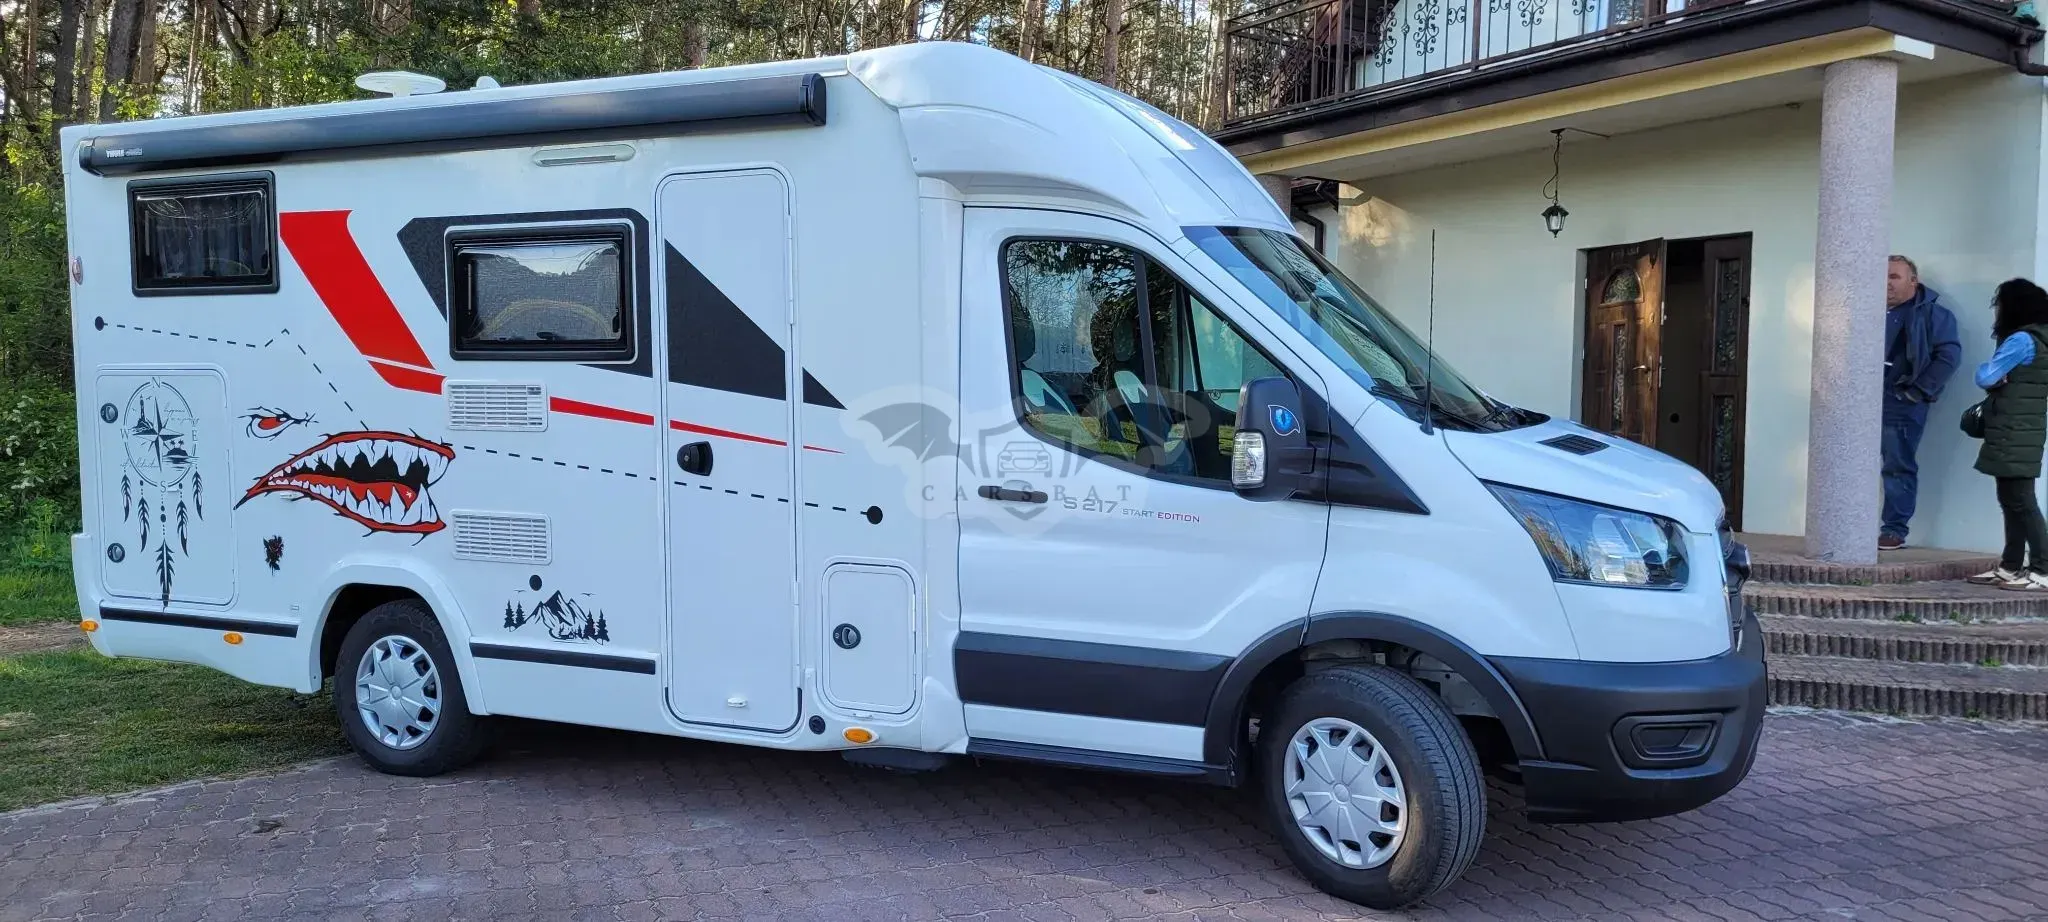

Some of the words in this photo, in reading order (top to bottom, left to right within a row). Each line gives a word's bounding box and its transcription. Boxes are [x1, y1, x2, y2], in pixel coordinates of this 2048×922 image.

[152, 376, 161, 389] N
[120, 428, 130, 440] W
[192, 429, 198, 441] E
[160, 480, 167, 493] S
[1063, 496, 1078, 510] S
[1082, 498, 1119, 513] 217
[1122, 508, 1155, 518] START
[1157, 511, 1200, 523] EDITION
